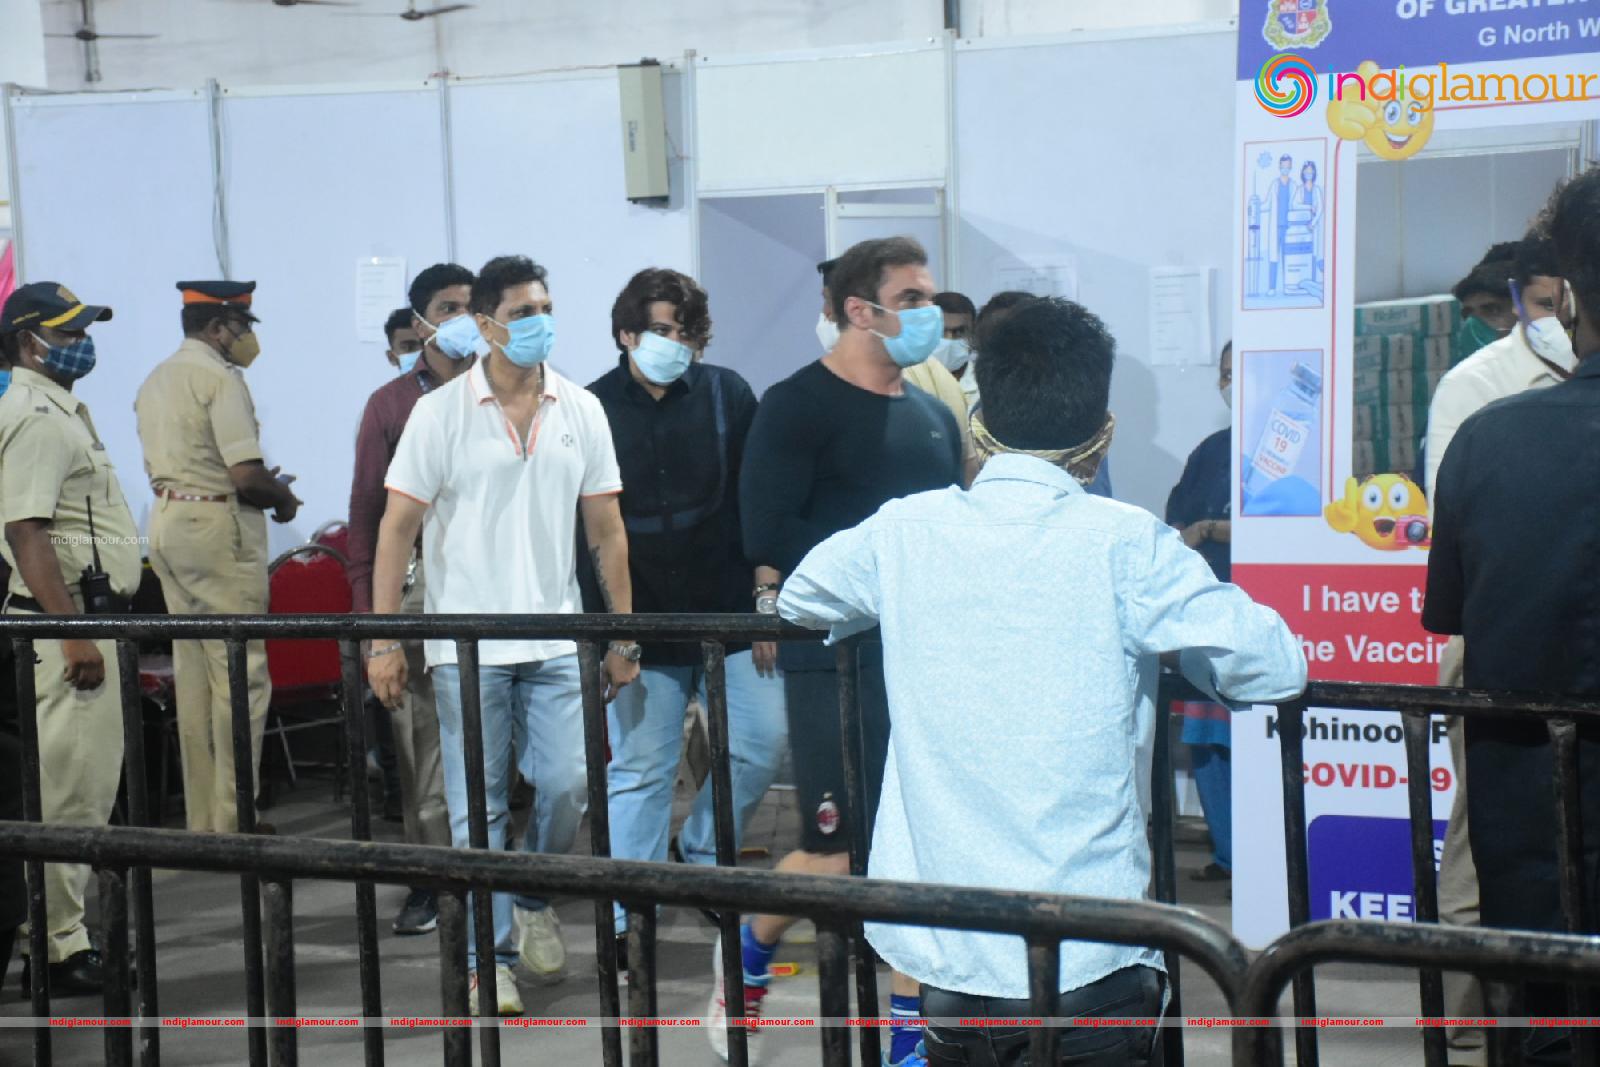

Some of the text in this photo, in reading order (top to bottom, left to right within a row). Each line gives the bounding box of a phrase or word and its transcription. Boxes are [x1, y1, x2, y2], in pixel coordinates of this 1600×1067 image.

[1396, 0, 1436, 19] OF
[1478, 27, 1497, 47] G
[1503, 21, 1570, 45] North
[1271, 419, 1301, 444] COVID
[1274, 436, 1288, 453] 19
[1303, 585, 1425, 613] I have t
[1293, 633, 1335, 662] he
[1266, 715, 1404, 744] Khinoo
[1302, 762, 1452, 792] OVID-9
[1331, 891, 1416, 922] KEE
